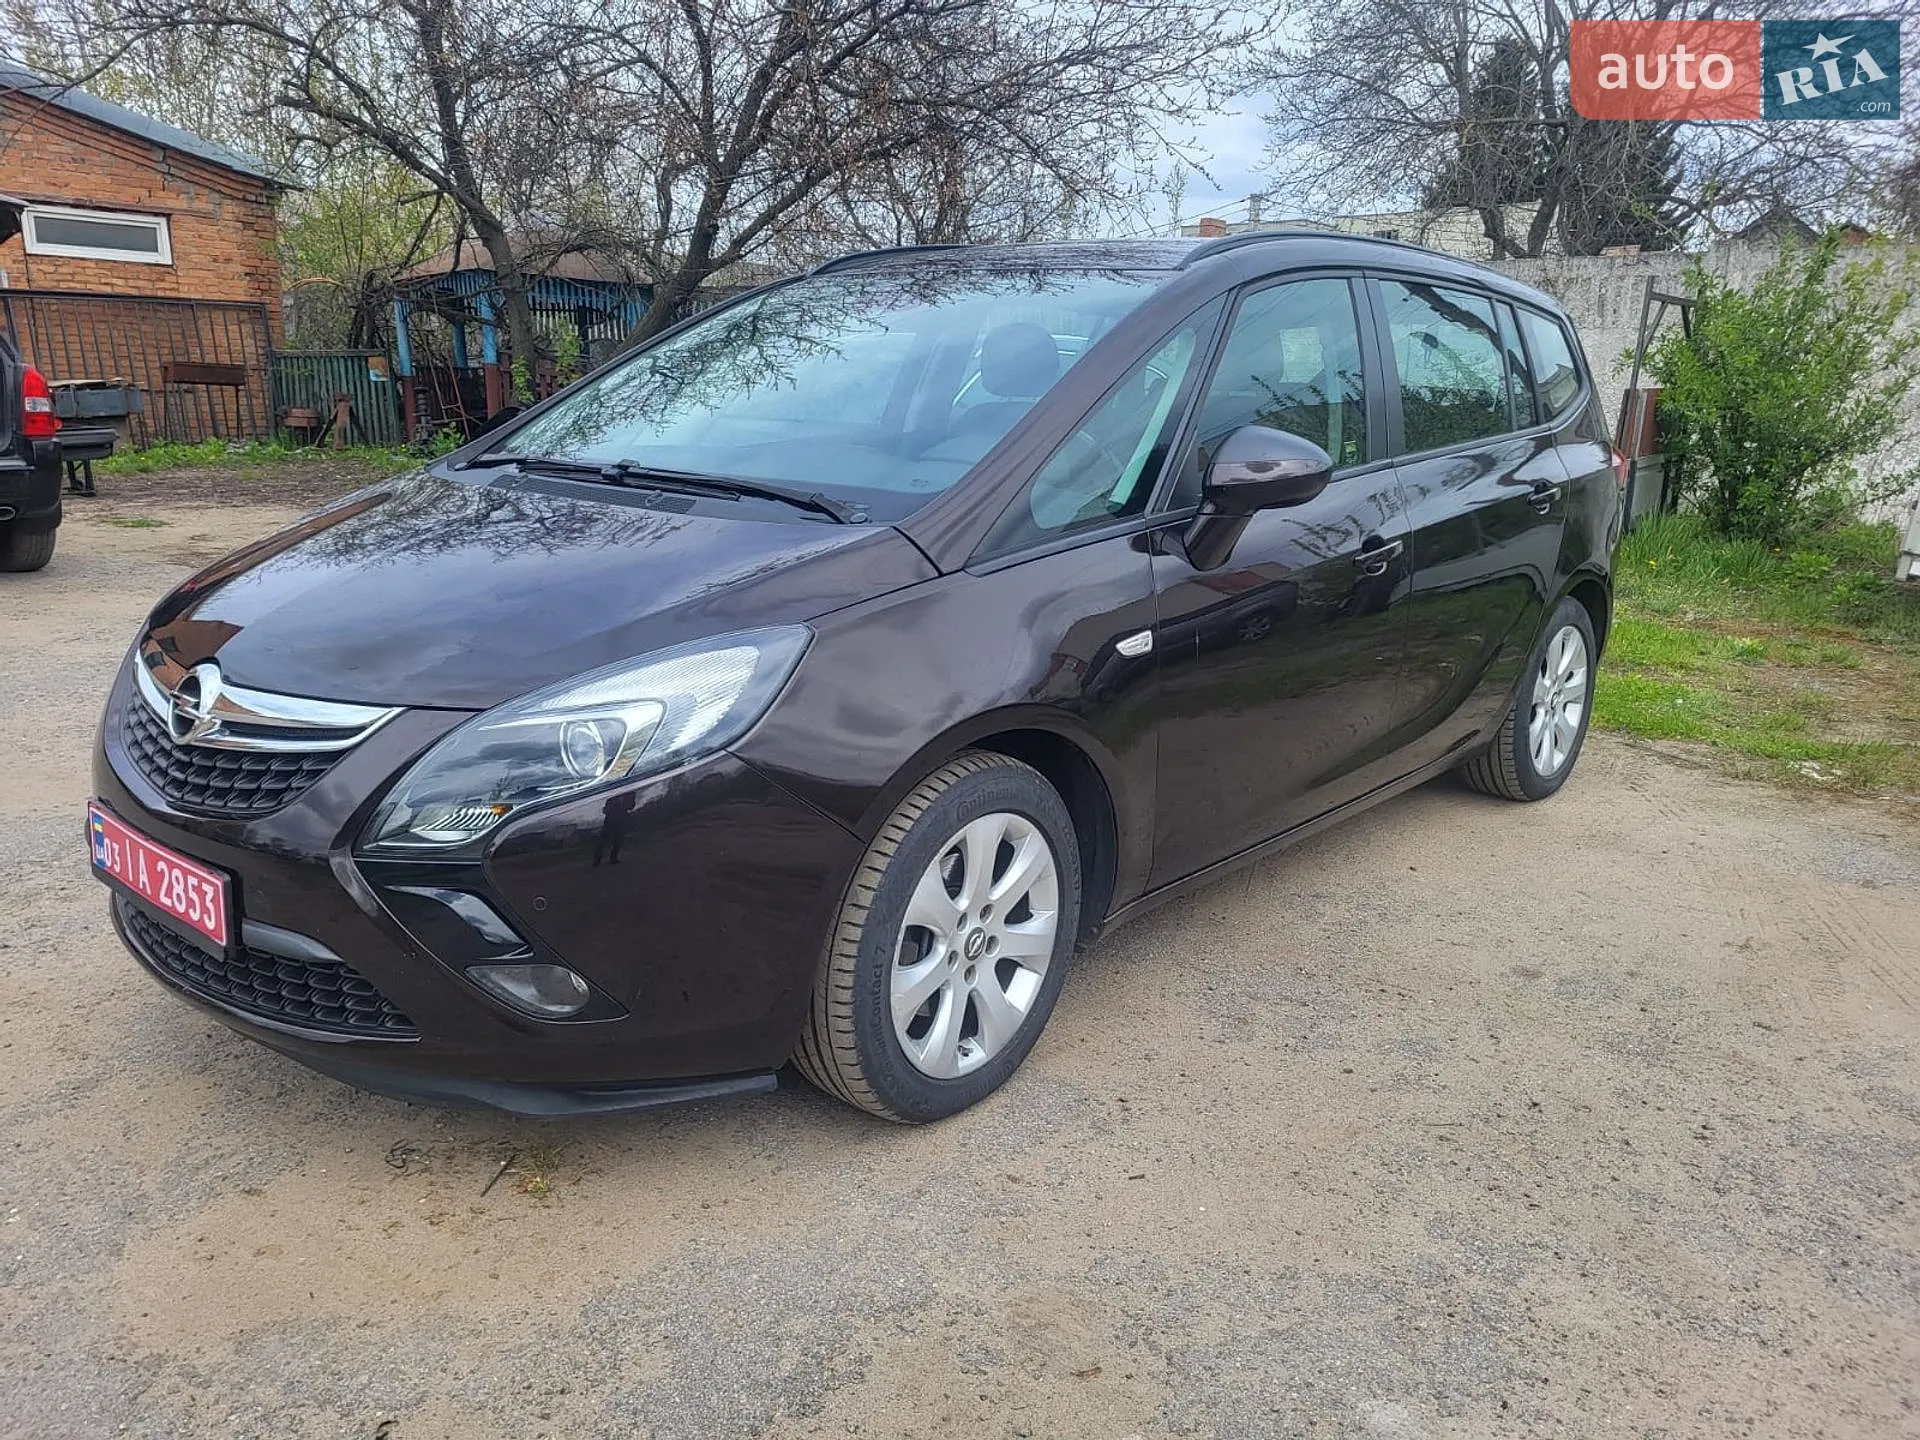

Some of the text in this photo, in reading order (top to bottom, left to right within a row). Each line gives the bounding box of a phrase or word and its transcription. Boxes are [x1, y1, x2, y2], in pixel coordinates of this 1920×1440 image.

[95, 844, 105, 860] UA
[103, 837, 121, 873] 03
[156, 862, 217, 931] 2853
